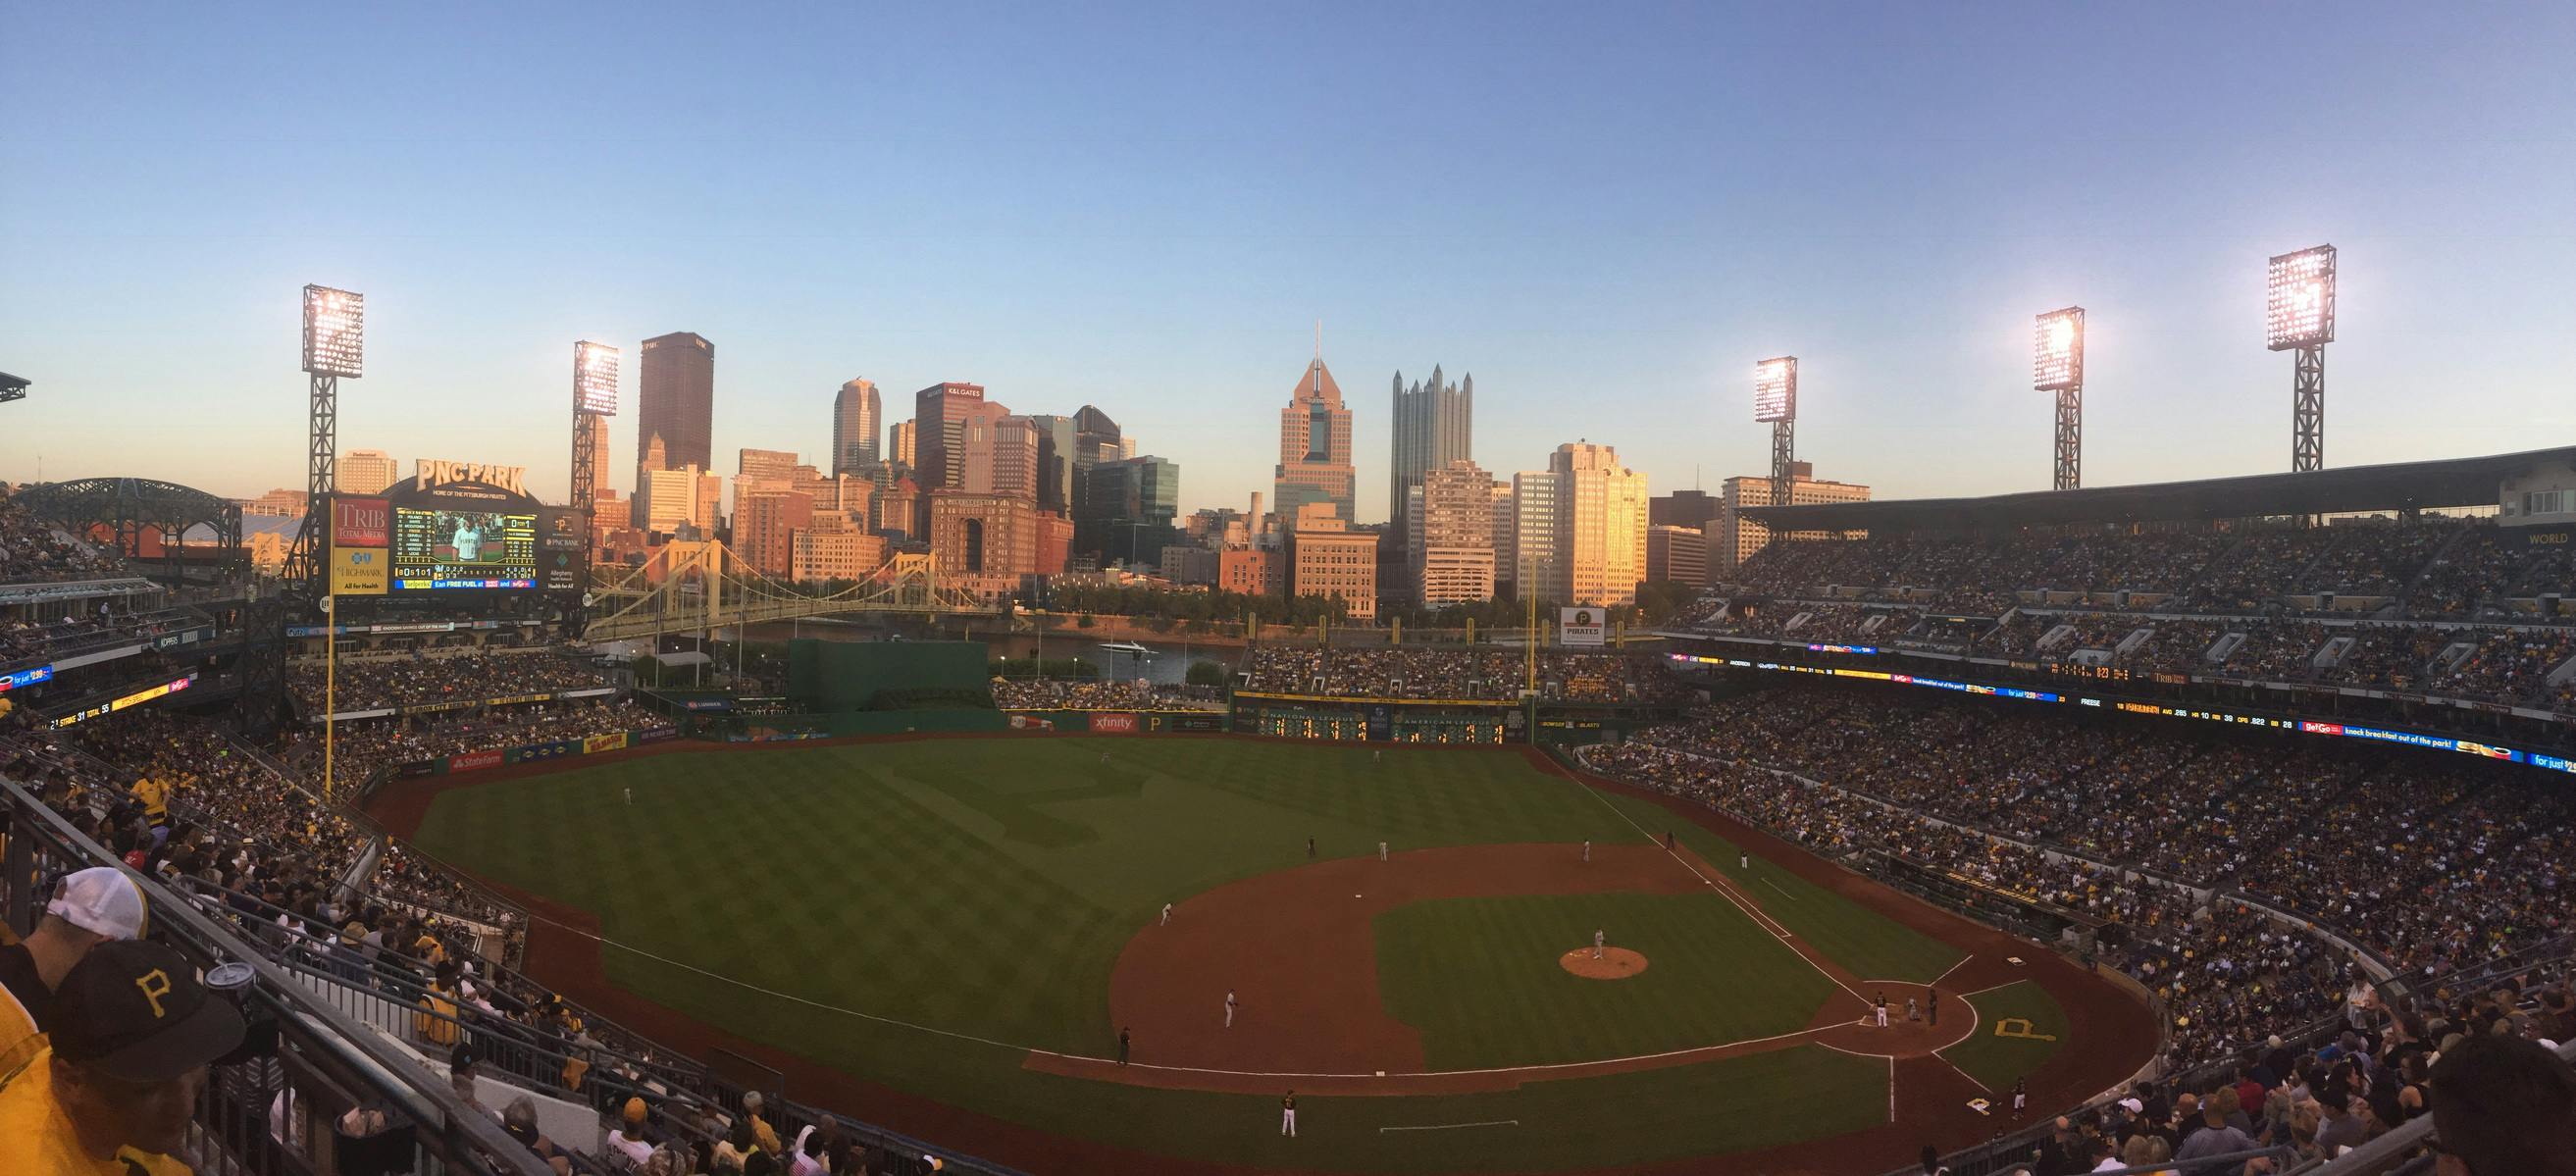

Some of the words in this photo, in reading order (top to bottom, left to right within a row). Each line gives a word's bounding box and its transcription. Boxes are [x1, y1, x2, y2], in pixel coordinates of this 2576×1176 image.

[959, 389, 980, 397] GATES
[416, 459, 465, 492] PNC
[468, 462, 527, 499] PARK
[338, 504, 385, 528] TRIB
[526, 520, 529, 528] 1
[338, 528, 362, 538] TOTAL
[363, 530, 385, 539] MEDIA
[2529, 533, 2568, 544] WORLD
[404, 568, 410, 576] 0
[1580, 614, 1586, 624] P
[2155, 673, 2172, 683] TRIB
[59, 715, 77, 727] STRIKE
[77, 711, 85, 722] 31
[87, 708, 100, 719] TOTAL
[2081, 698, 2101, 707] FREESE
[2250, 717, 2265, 726] .822
[1096, 717, 1132, 729] xfinity
[1151, 717, 1161, 731] P
[2306, 723, 2330, 733] getGo
[2345, 727, 2364, 736] knock
[2365, 729, 2397, 739] breakfast
[2419, 736, 2431, 745] the
[2432, 740, 2452, 750] park!
[2535, 755, 2548, 766] for
[2549, 757, 2564, 768] just
[136, 968, 171, 1019] P
[1994, 1018, 2057, 1041] P
